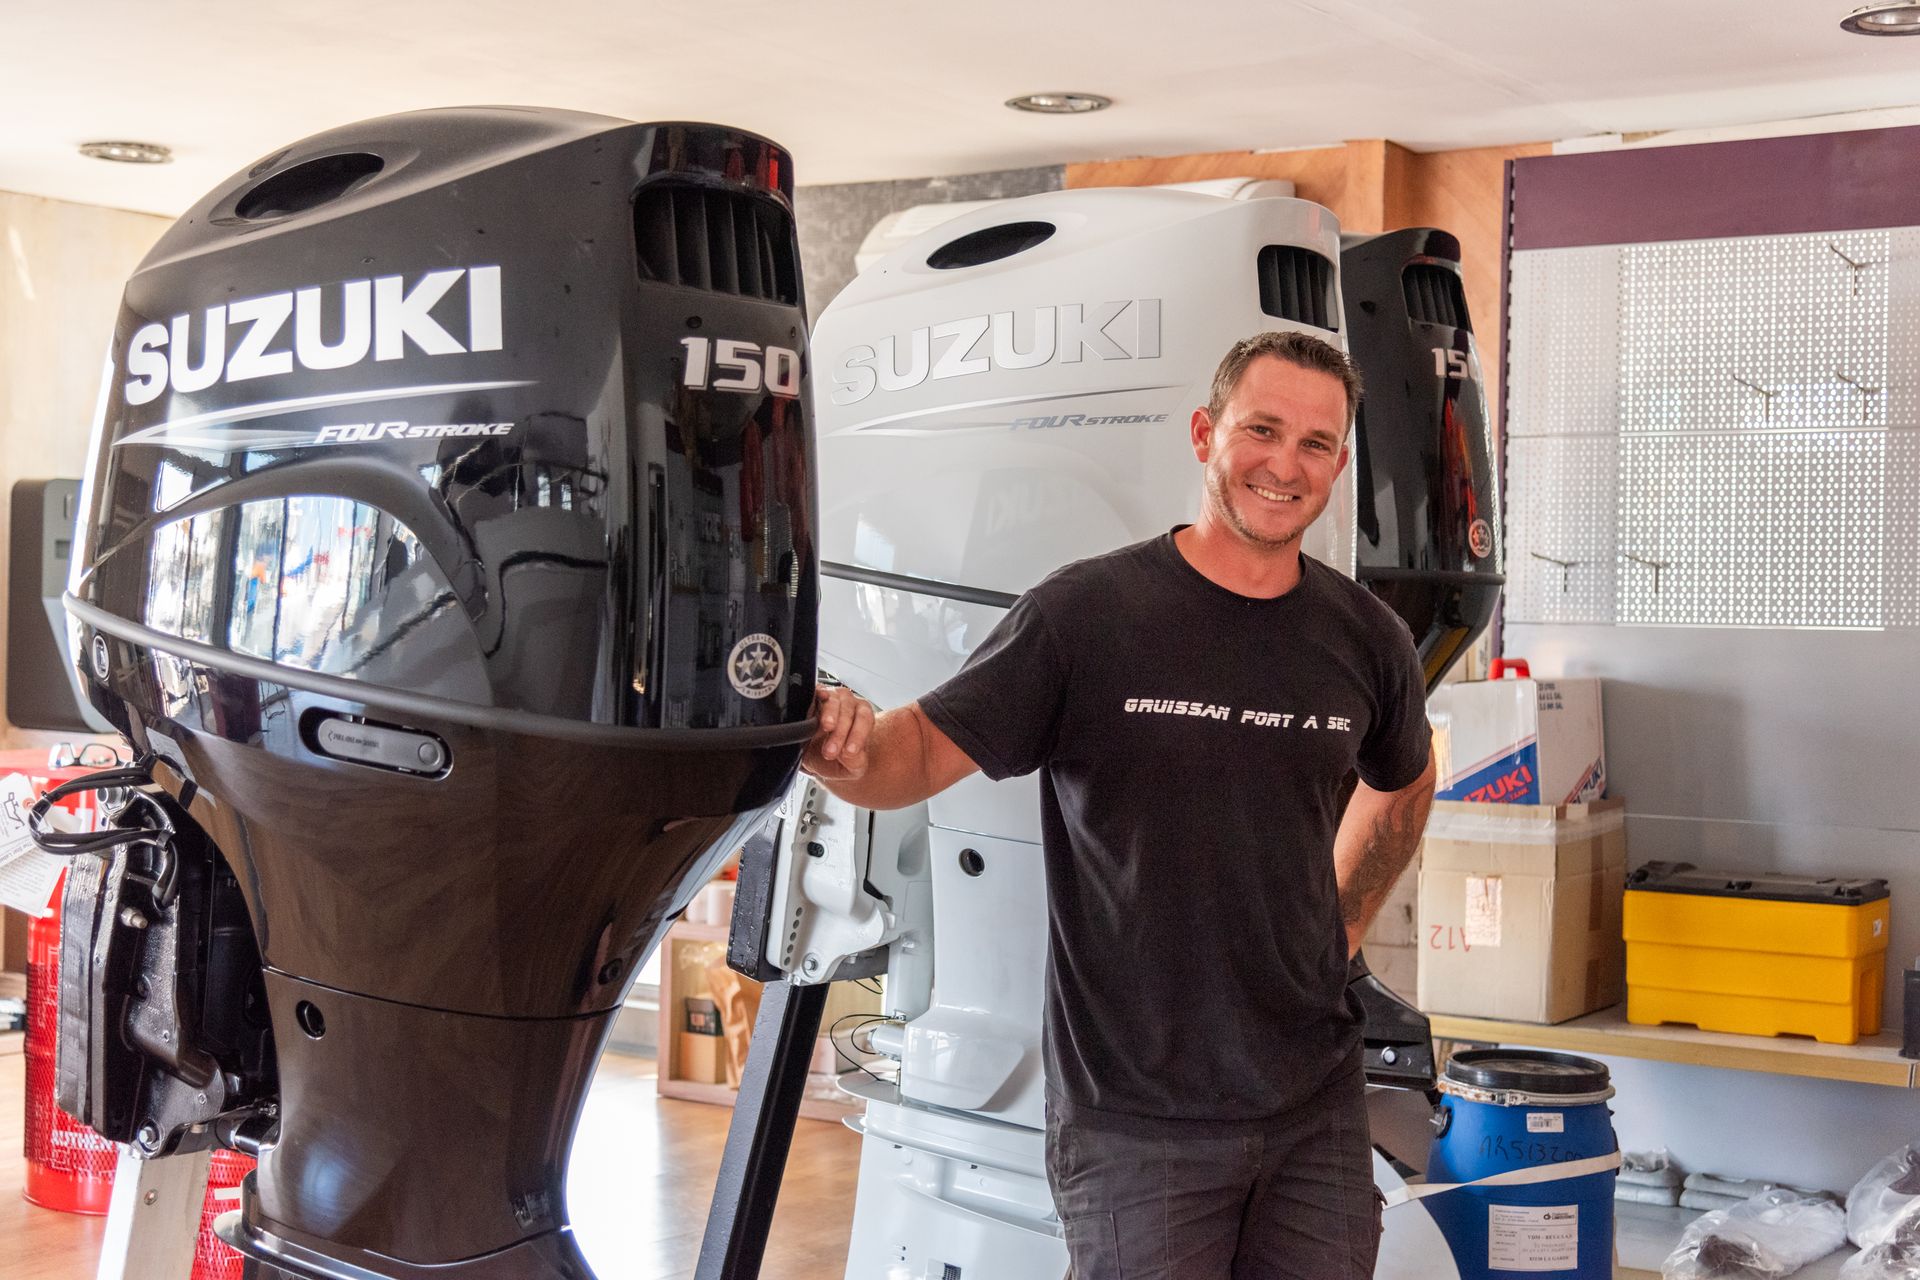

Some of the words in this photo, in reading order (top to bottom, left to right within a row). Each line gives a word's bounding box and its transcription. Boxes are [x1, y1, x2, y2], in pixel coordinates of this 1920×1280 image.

[125, 266, 503, 406] SUZUKI
[831, 298, 1161, 406] SUZUKI
[680, 336, 800, 399] 150
[314, 420, 410, 445] FOUR
[405, 422, 515, 439] STROKE
[1009, 414, 1087, 431] FOUR
[1084, 413, 1168, 427] STROKE
[1124, 698, 1231, 721] GRUISSAN
[1240, 709, 1295, 729] PORT
[1302, 714, 1319, 730] A
[1326, 716, 1351, 732] SEC
[1463, 765, 1534, 803] ZUKI
